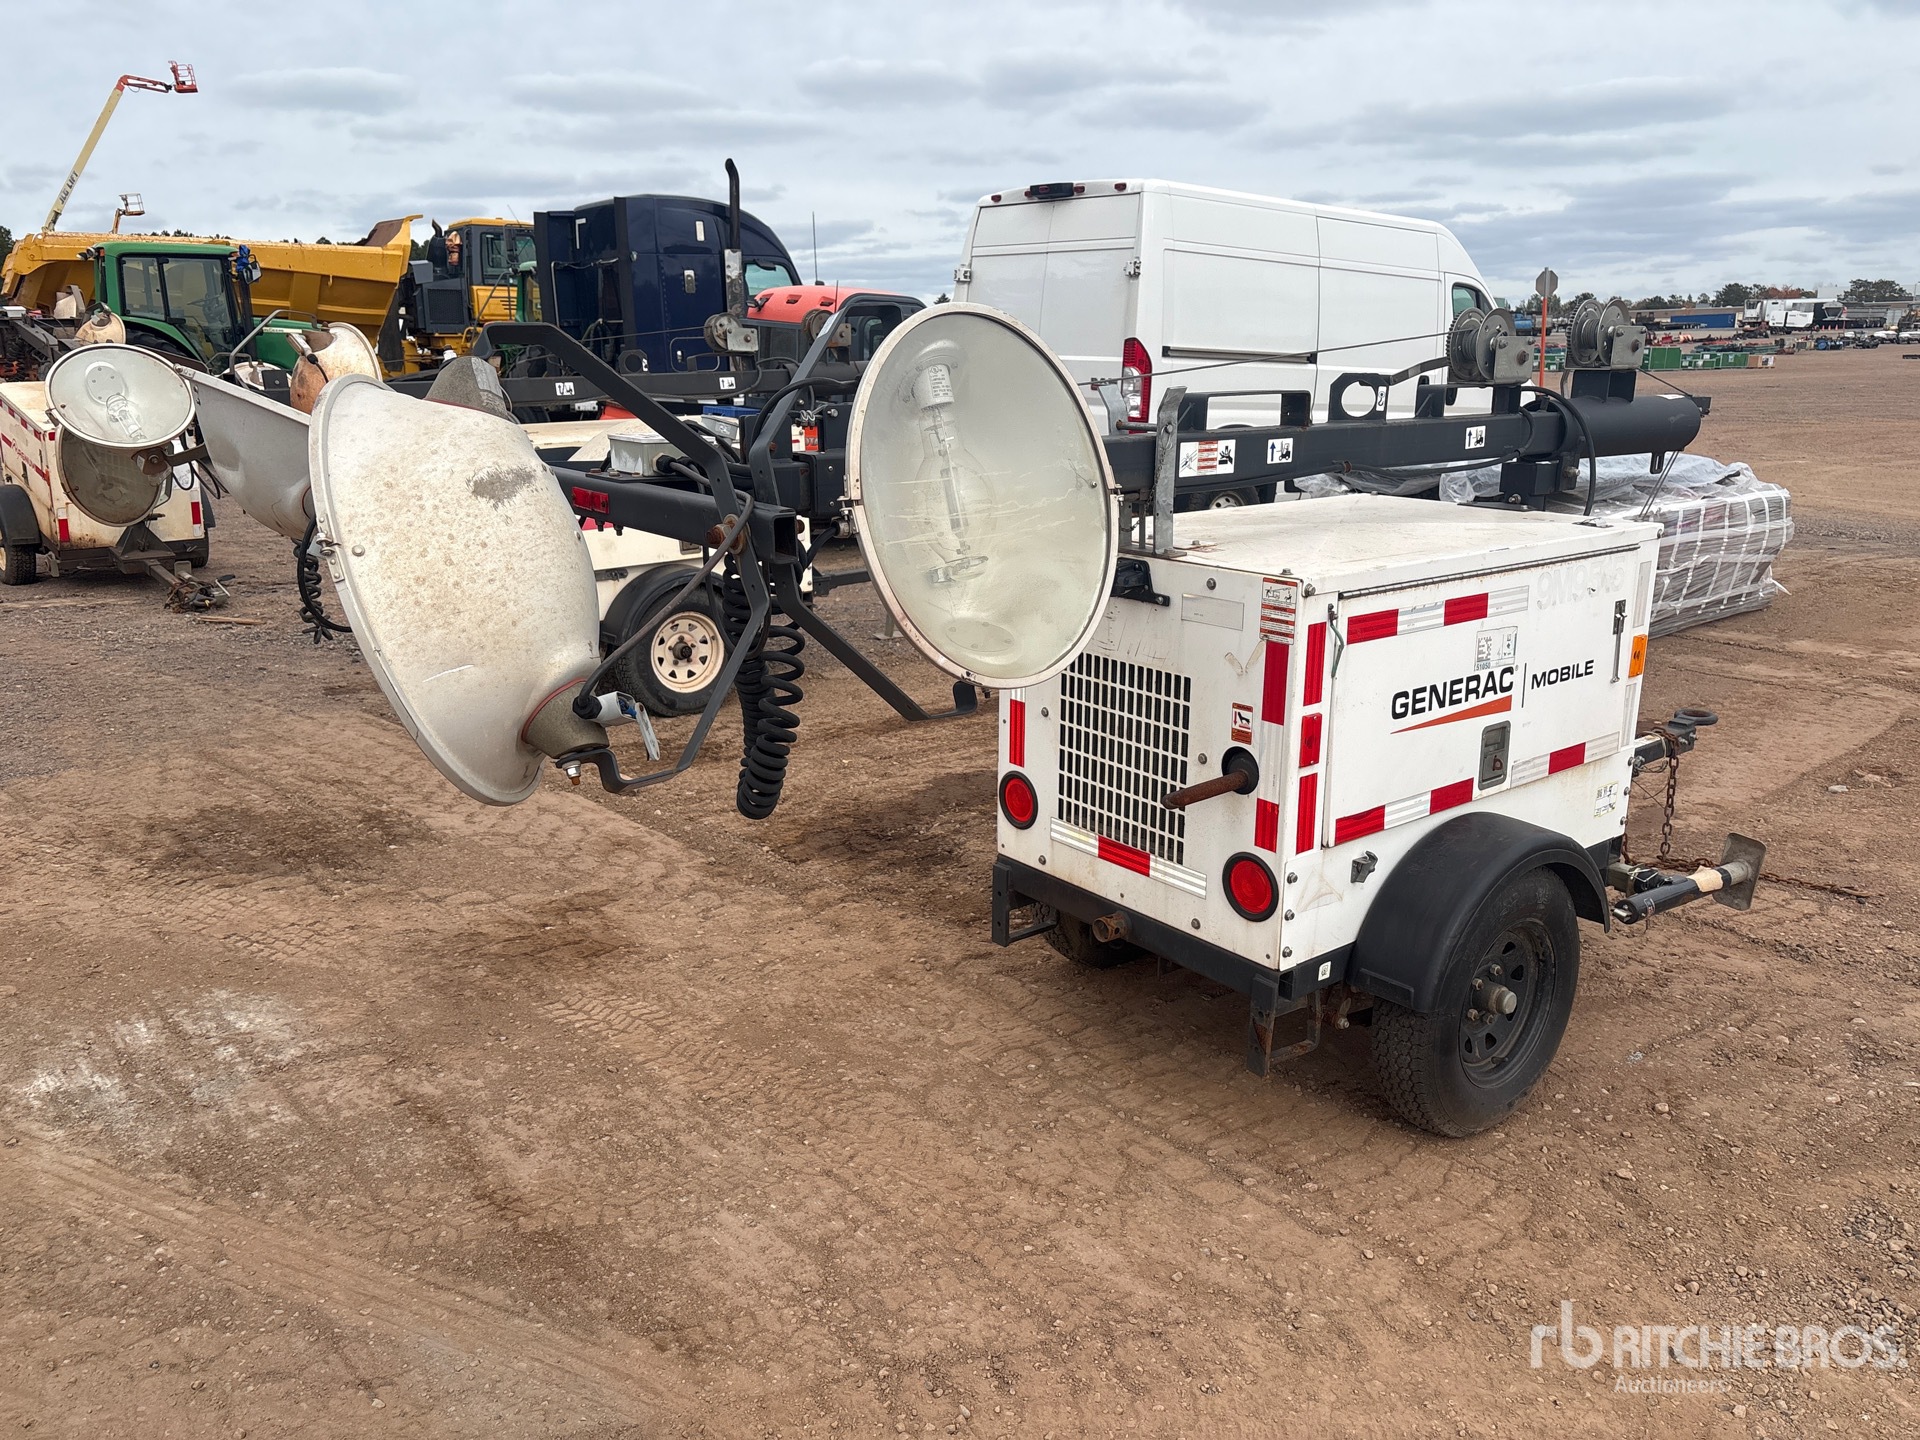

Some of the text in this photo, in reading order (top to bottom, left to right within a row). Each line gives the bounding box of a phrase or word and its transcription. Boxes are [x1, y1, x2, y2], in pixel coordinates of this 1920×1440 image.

[67, 170, 78, 190] LIFT
[1391, 659, 1594, 720] GENERAC MOBILE
